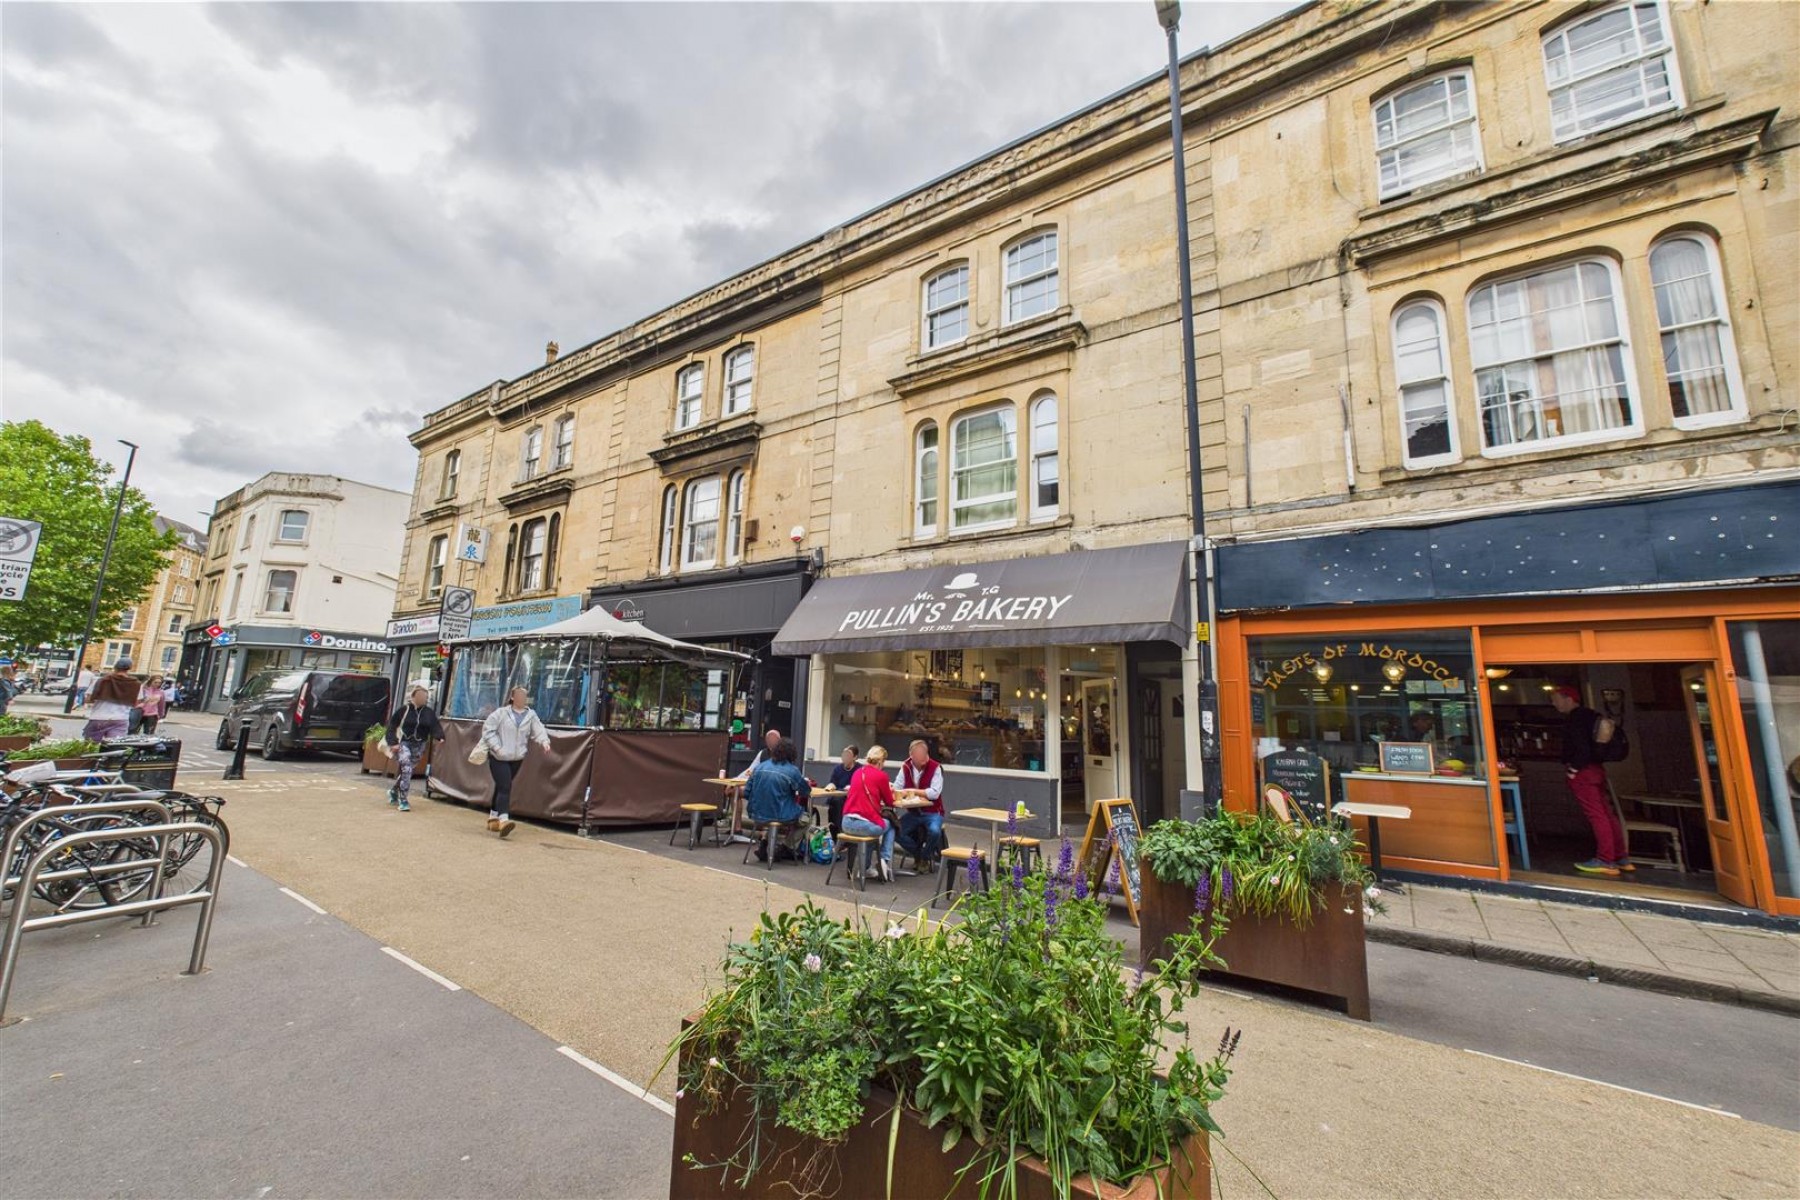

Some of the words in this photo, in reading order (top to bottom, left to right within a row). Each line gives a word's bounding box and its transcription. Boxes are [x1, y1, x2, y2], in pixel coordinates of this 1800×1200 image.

[1, 563, 28, 572] trian
[0, 571, 24, 579] ycle
[913, 591, 935, 601] Mr.
[838, 602, 946, 632] PULLIN'S
[951, 594, 1073, 622] BAKERY
[321, 635, 397, 652] Domino
[1263, 652, 1315, 690] TASTE
[1323, 644, 1347, 660] OF
[1358, 642, 1460, 689] MOROCCO
